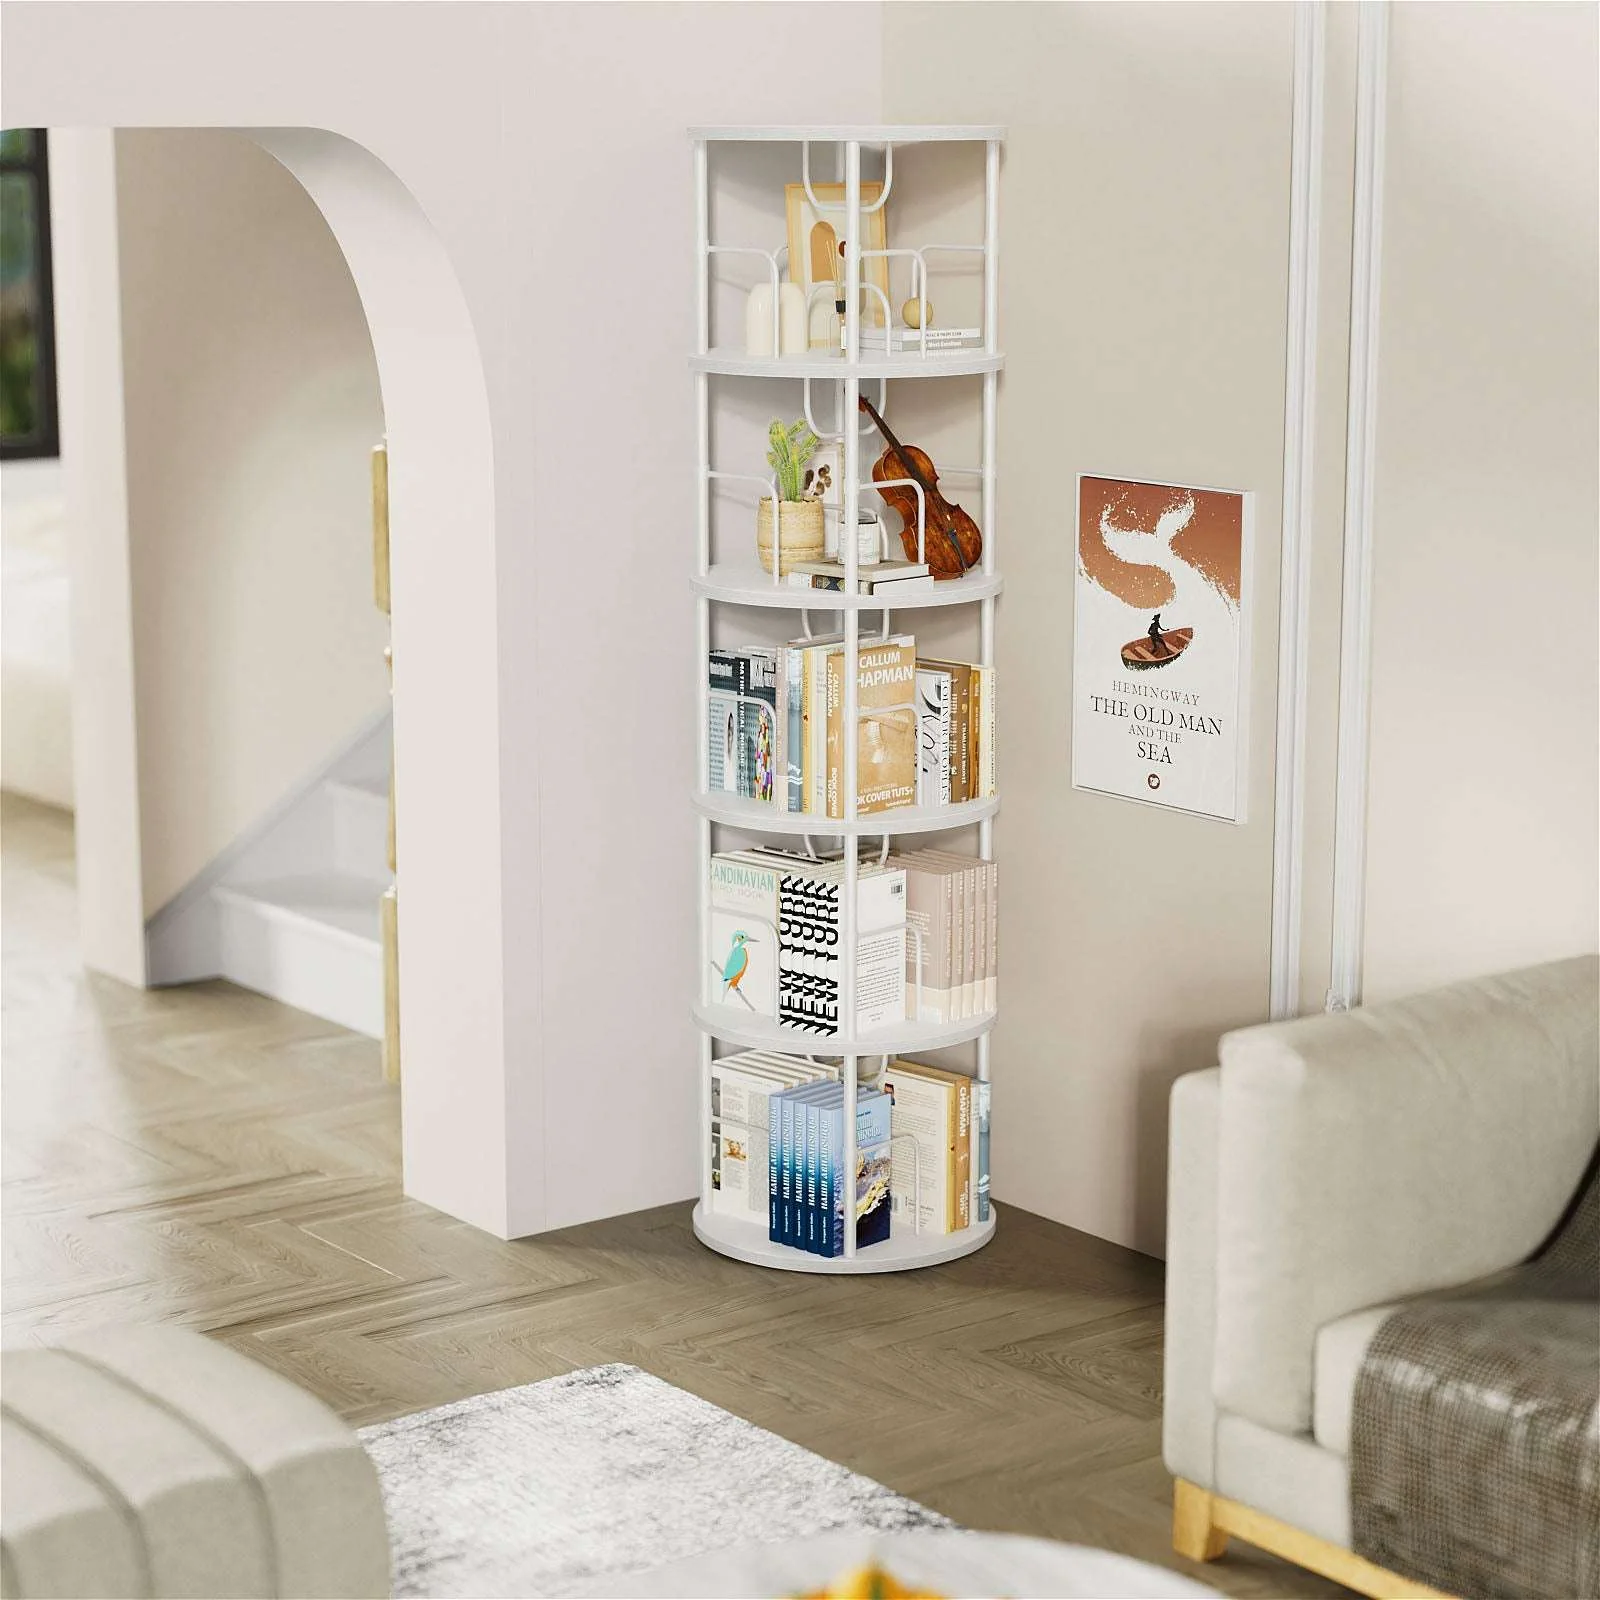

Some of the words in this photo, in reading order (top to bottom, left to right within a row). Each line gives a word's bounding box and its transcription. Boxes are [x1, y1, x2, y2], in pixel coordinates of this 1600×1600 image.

[859, 651, 901, 669] CALLUM
[857, 665, 913, 688] HAPMAN
[1112, 680, 1199, 706] HEMINGWAY
[1090, 695, 1129, 718] THE
[1134, 703, 1174, 726] OLD
[1179, 713, 1222, 736] MAN
[1128, 724, 1154, 738] AND
[1157, 729, 1182, 744] THE
[1137, 741, 1174, 764] SEA
[866, 789, 891, 803] COVER
[891, 786, 914, 799] TUTS+
[711, 863, 774, 893] ANDINAVIAN
